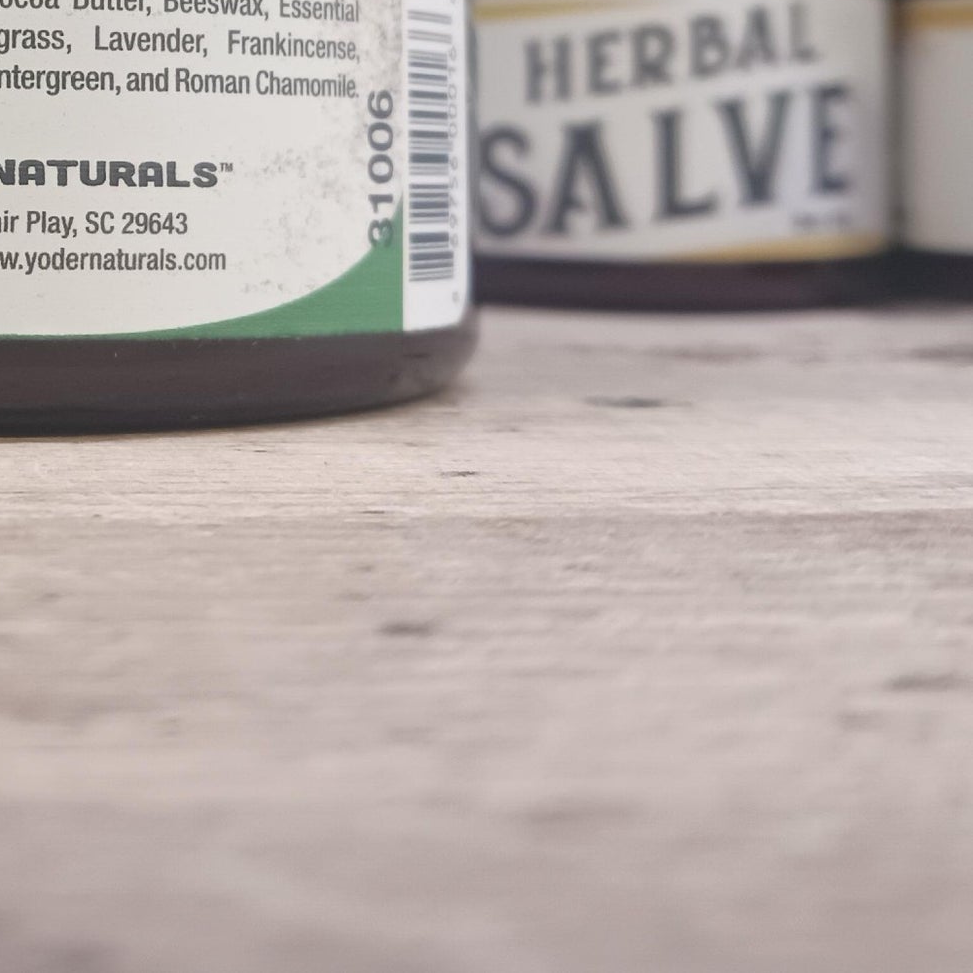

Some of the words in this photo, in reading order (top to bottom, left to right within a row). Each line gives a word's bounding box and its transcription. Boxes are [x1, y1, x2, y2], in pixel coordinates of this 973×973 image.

[94, 25, 208, 57] Lavender,
[227, 29, 361, 63] Frankincense,
[525, 1, 823, 103] HERBAL
[127, 68, 169, 92] and
[175, 68, 250, 95] Roman
[256, 70, 359, 98] Chamomile.
[367, 89, 394, 248] 31006
[478, 81, 850, 237] SALVE
[26, 211, 77, 239] Play,
[85, 212, 115, 234] SC
[122, 212, 188, 235] 29643
